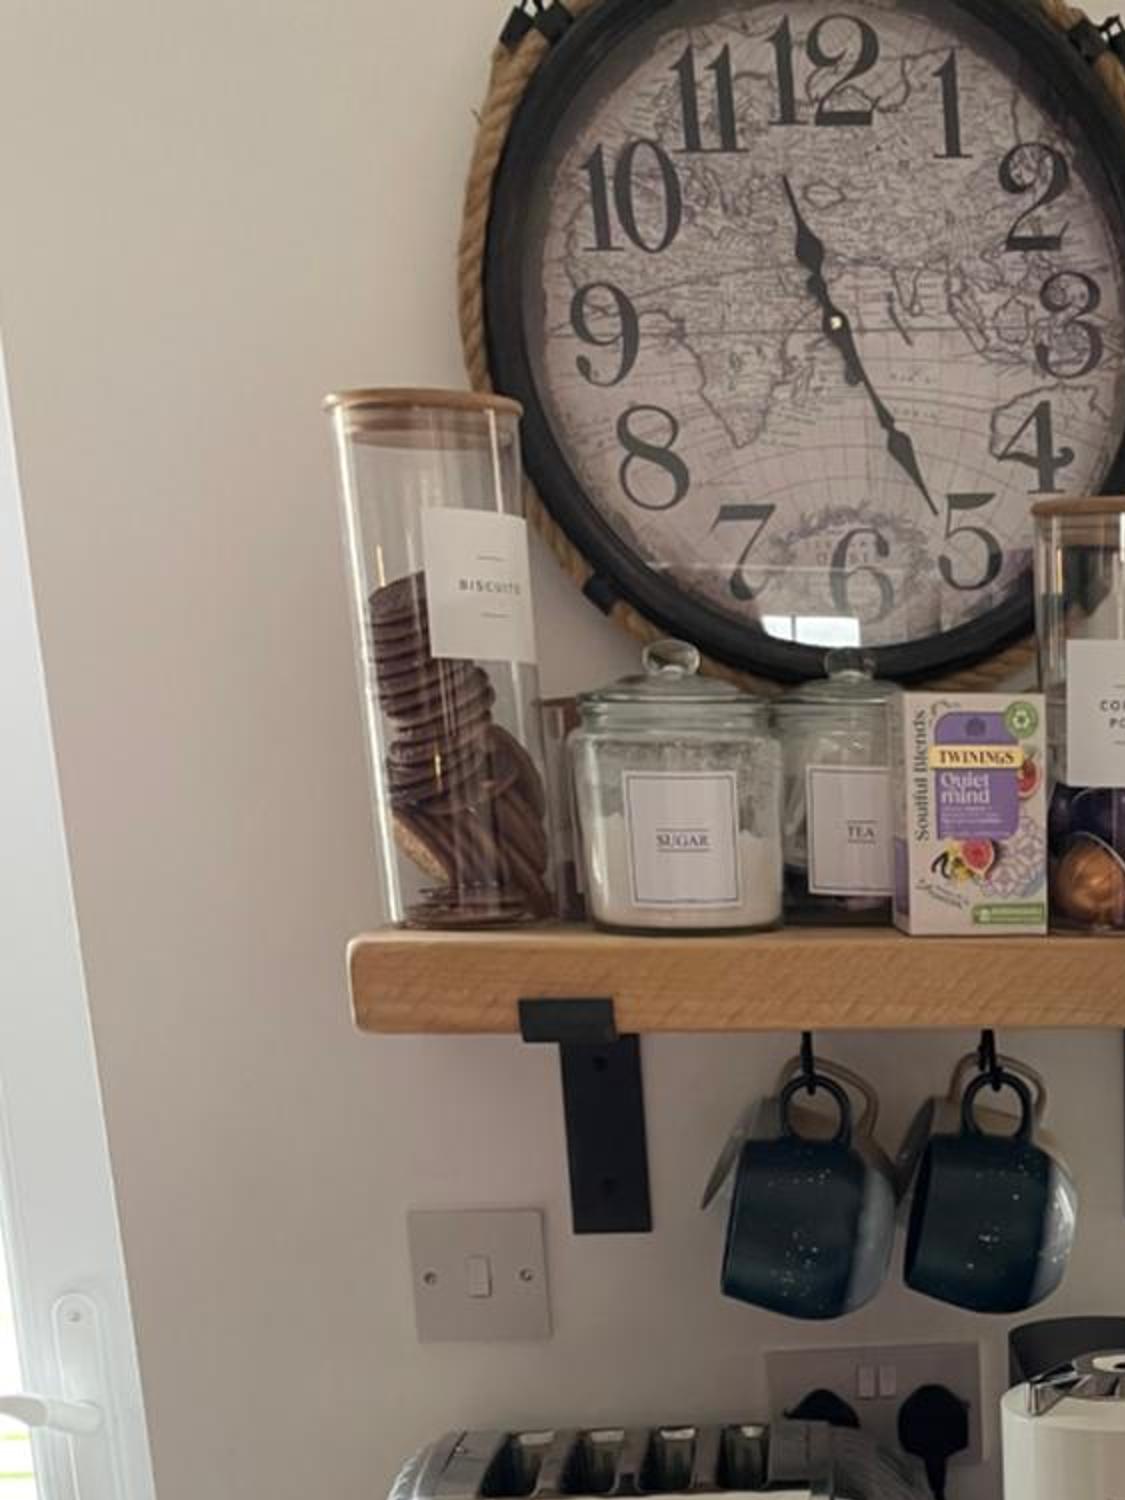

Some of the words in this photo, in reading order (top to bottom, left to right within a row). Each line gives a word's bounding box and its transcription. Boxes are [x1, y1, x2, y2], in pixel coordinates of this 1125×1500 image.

[669, 43, 750, 154] 11
[766, 13, 880, 126] 12
[932, 47, 974, 160] 1
[578, 138, 683, 254] 10
[998, 141, 1070, 251] 2
[569, 280, 640, 388] 9
[1035, 271, 1103, 380] 3
[616, 403, 691, 511] 8
[997, 400, 1076, 495] 4
[458, 578, 522, 596] BISCUITS
[710, 503, 778, 600] 7
[829, 527, 896, 626] 6
[937, 493, 1004, 591] 5
[913, 708, 928, 772] Blends
[940, 750, 1015, 764] TWININGS
[940, 770, 990, 792] Quiet
[655, 833, 711, 848] SUGAR
[848, 826, 876, 839] TEA
[913, 777, 929, 842] Soulful
[940, 786, 991, 805] mind
